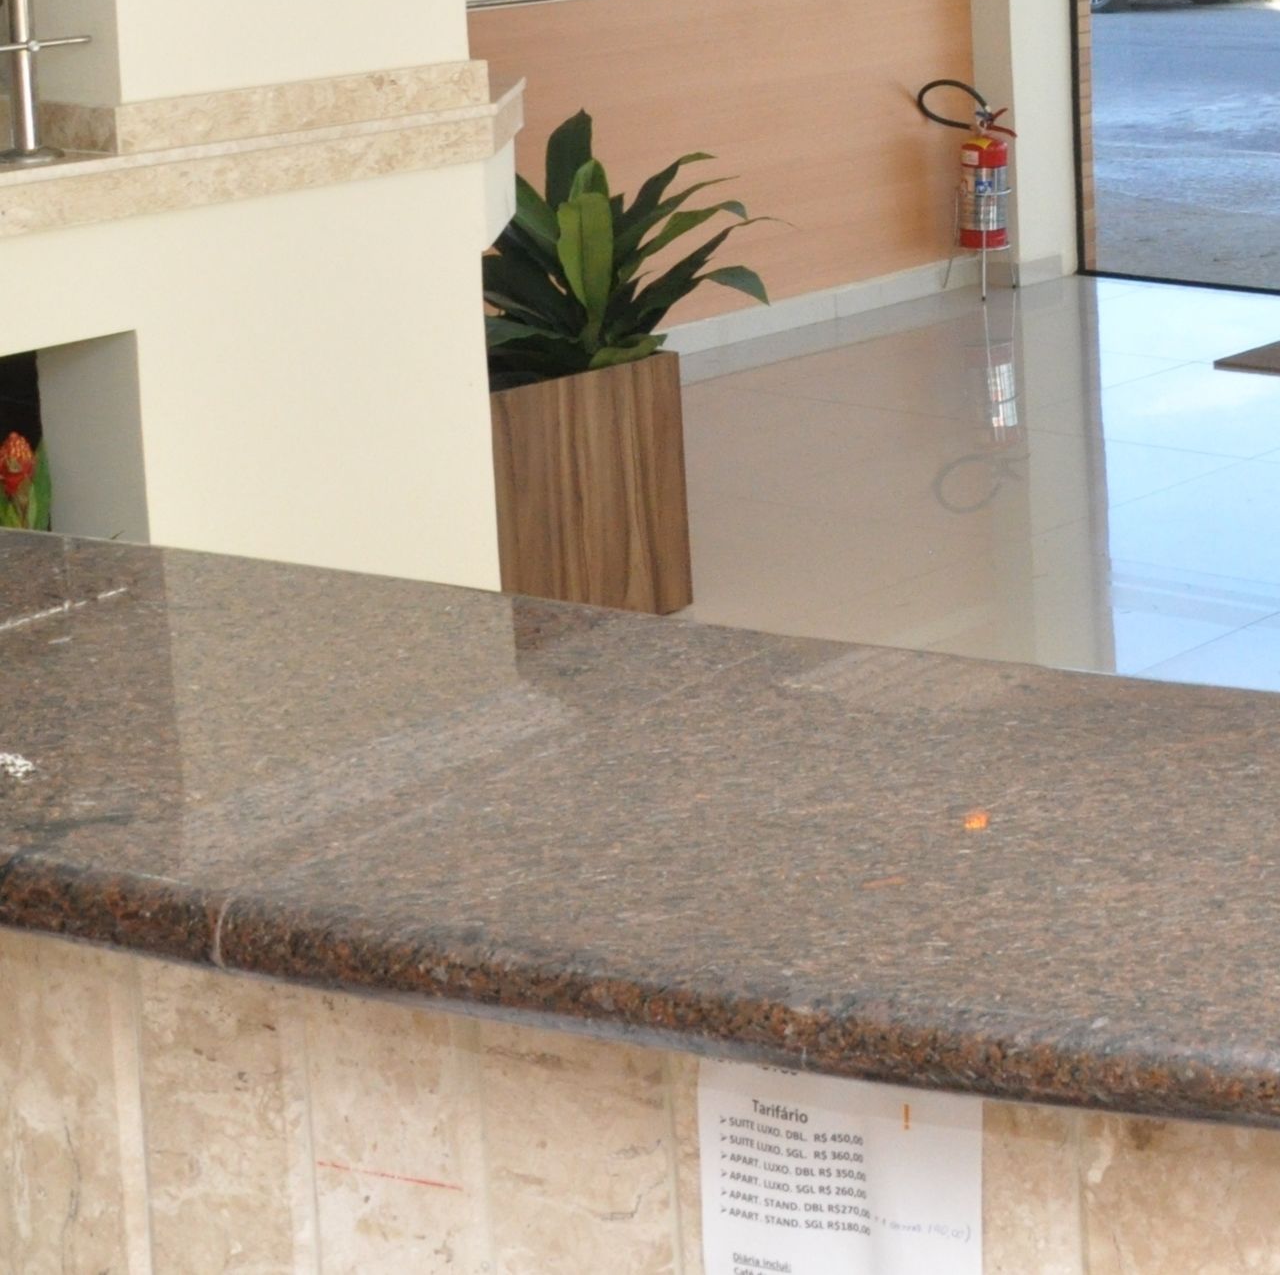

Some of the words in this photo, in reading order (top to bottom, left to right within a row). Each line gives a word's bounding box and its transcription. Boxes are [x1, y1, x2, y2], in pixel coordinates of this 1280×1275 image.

[752, 1099, 808, 1124] Tarifário
[729, 1116, 755, 1131] SUITE
[814, 1133, 827, 1143] R$
[729, 1134, 755, 1149] SUITE
[757, 1141, 783, 1156] LUXO.
[814, 1150, 827, 1161] R$
[730, 1153, 761, 1169] APART.
[795, 1167, 815, 1177] DBL
[818, 1168, 832, 1178] R$
[730, 1171, 761, 1187] APART.
[763, 1180, 792, 1193] LUXO.
[796, 1185, 815, 1194] SGL
[818, 1186, 832, 1196] R$
[730, 1190, 761, 1205] APART.
[764, 1198, 800, 1212] STAND.
[804, 1203, 824, 1212] DBL
[730, 1208, 761, 1222] APART.
[765, 1215, 802, 1229] STAND.
[804, 1220, 824, 1229] SGL
